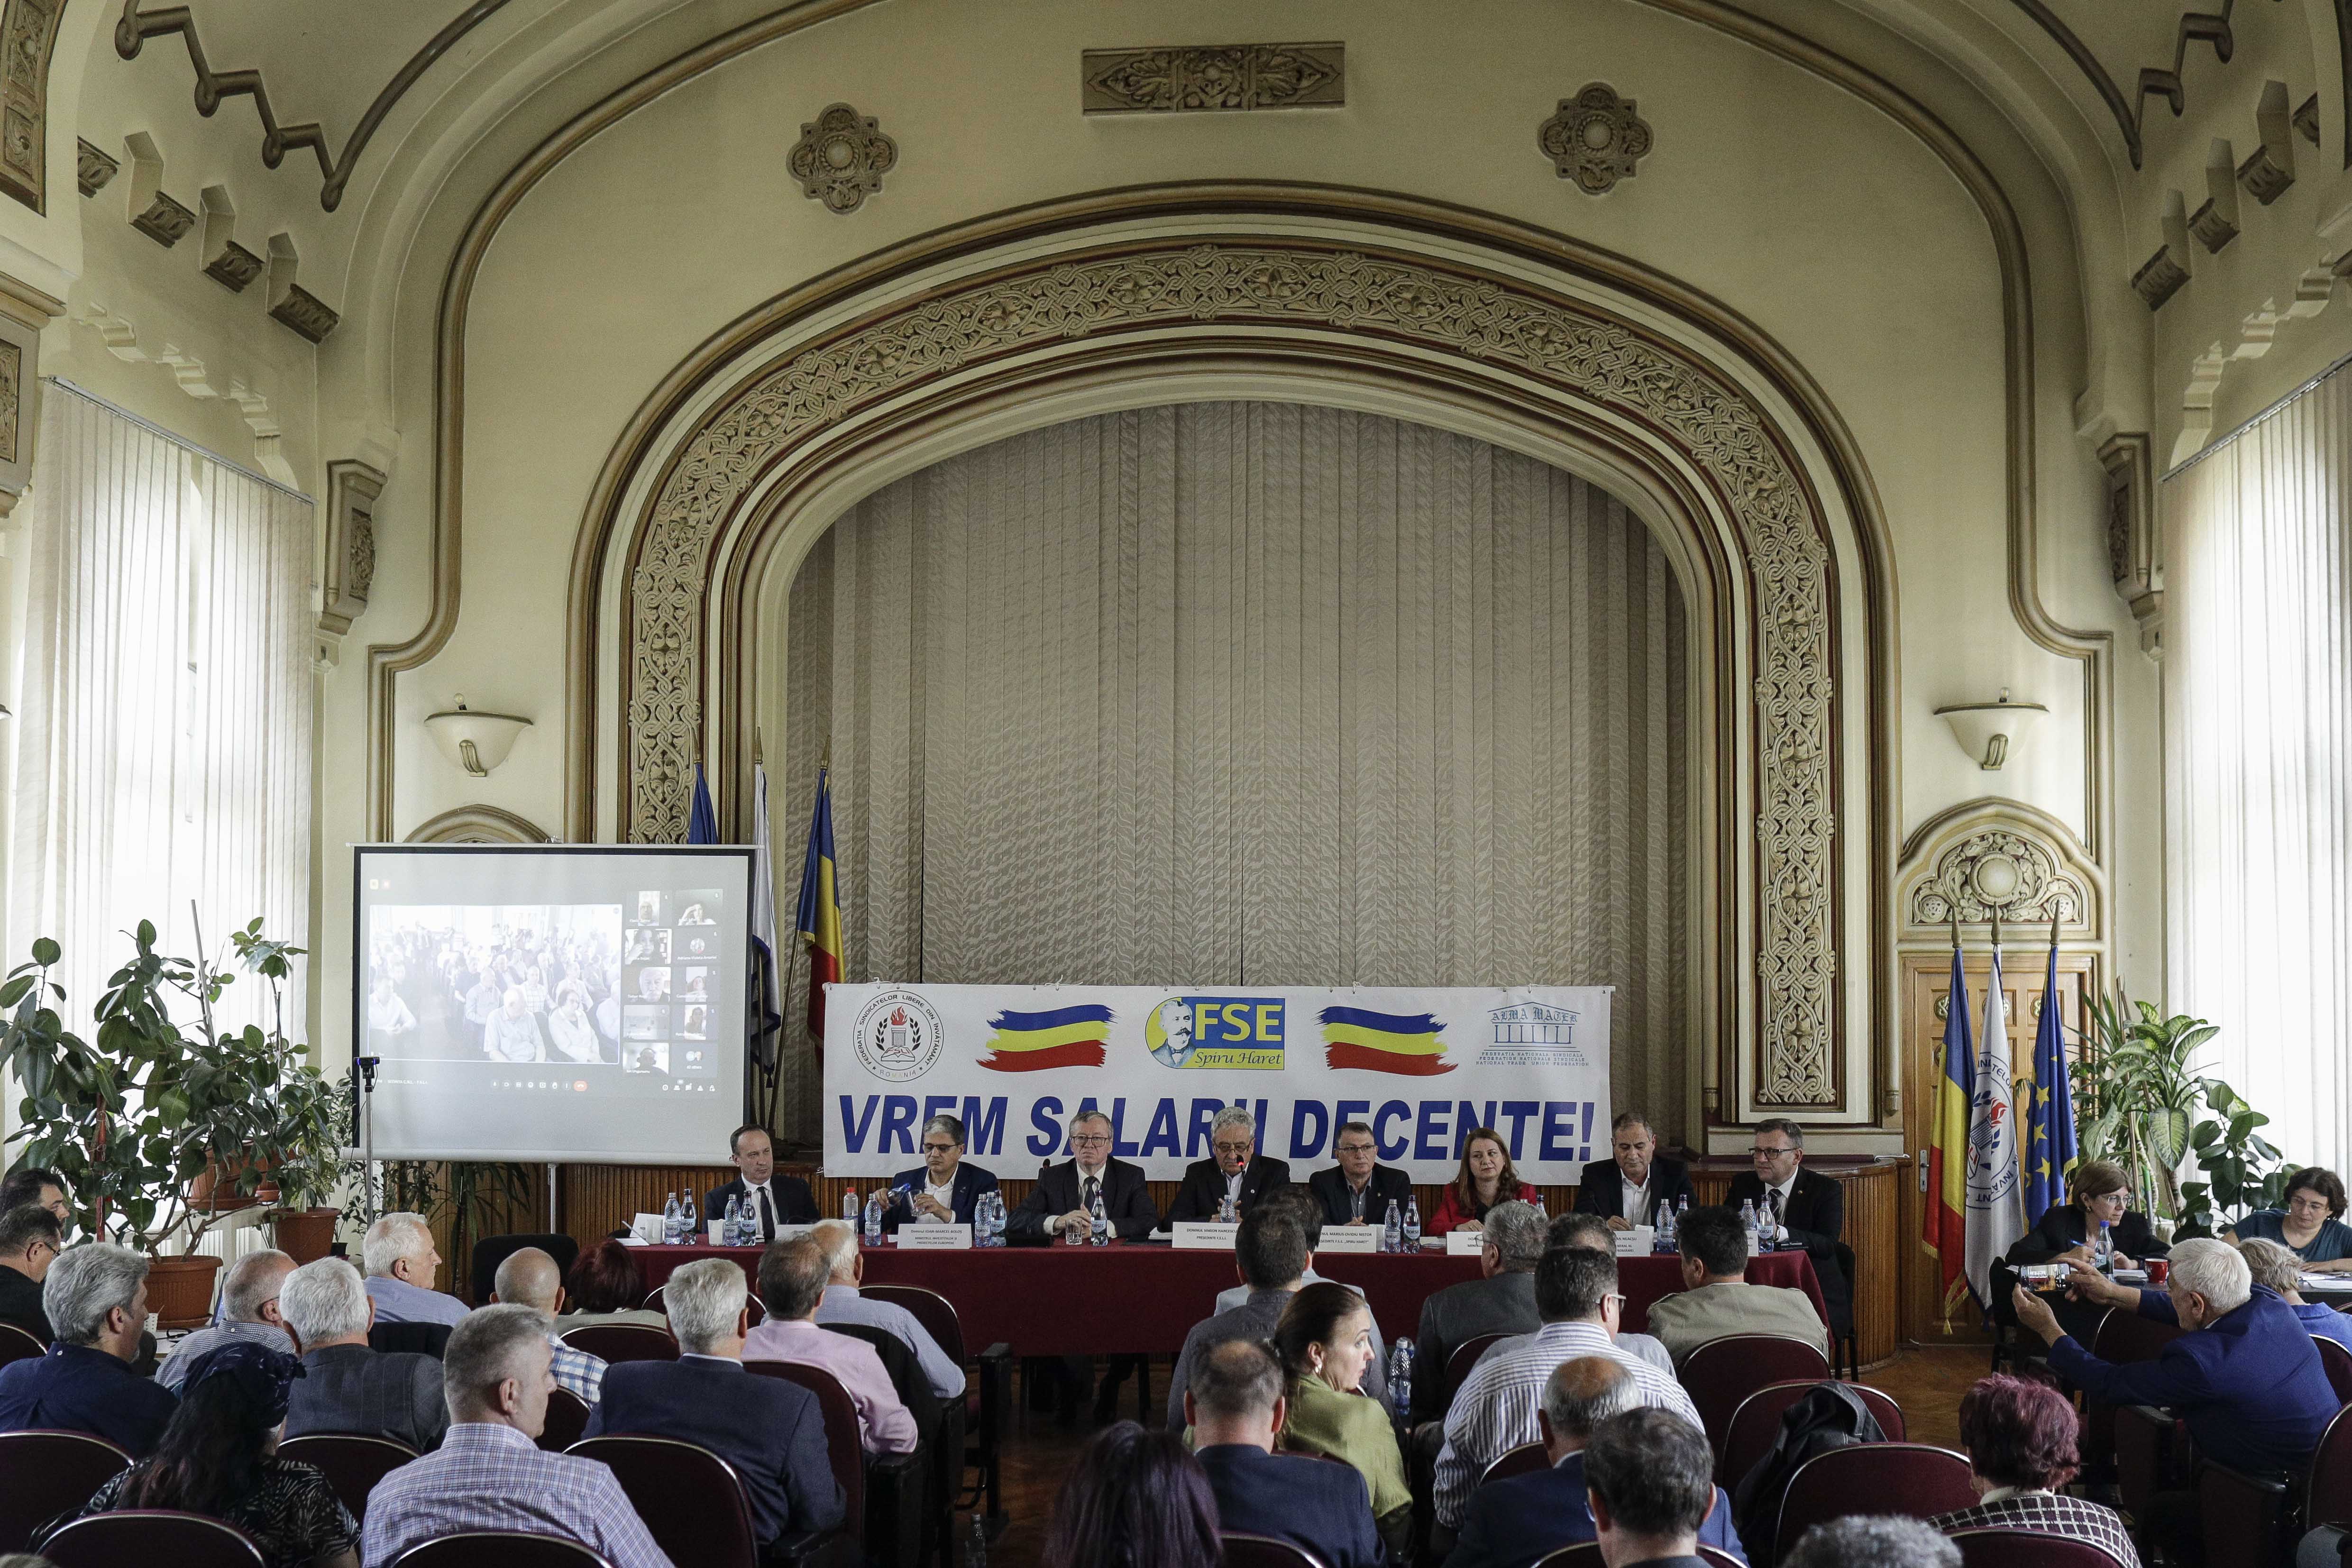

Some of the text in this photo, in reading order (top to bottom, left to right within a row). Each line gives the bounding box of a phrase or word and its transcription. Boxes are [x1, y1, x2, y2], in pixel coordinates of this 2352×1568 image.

[860, 994, 897, 1025] SINDICATELOR
[902, 995, 924, 1008] LIBERE
[925, 1009, 935, 1020] DIN
[1195, 1003, 1282, 1042] FSE
[1532, 1007, 1578, 1023] MATER
[1195, 1051, 1282, 1067] Spiru Haret
[1026, 1096, 1269, 1158] SLARI
